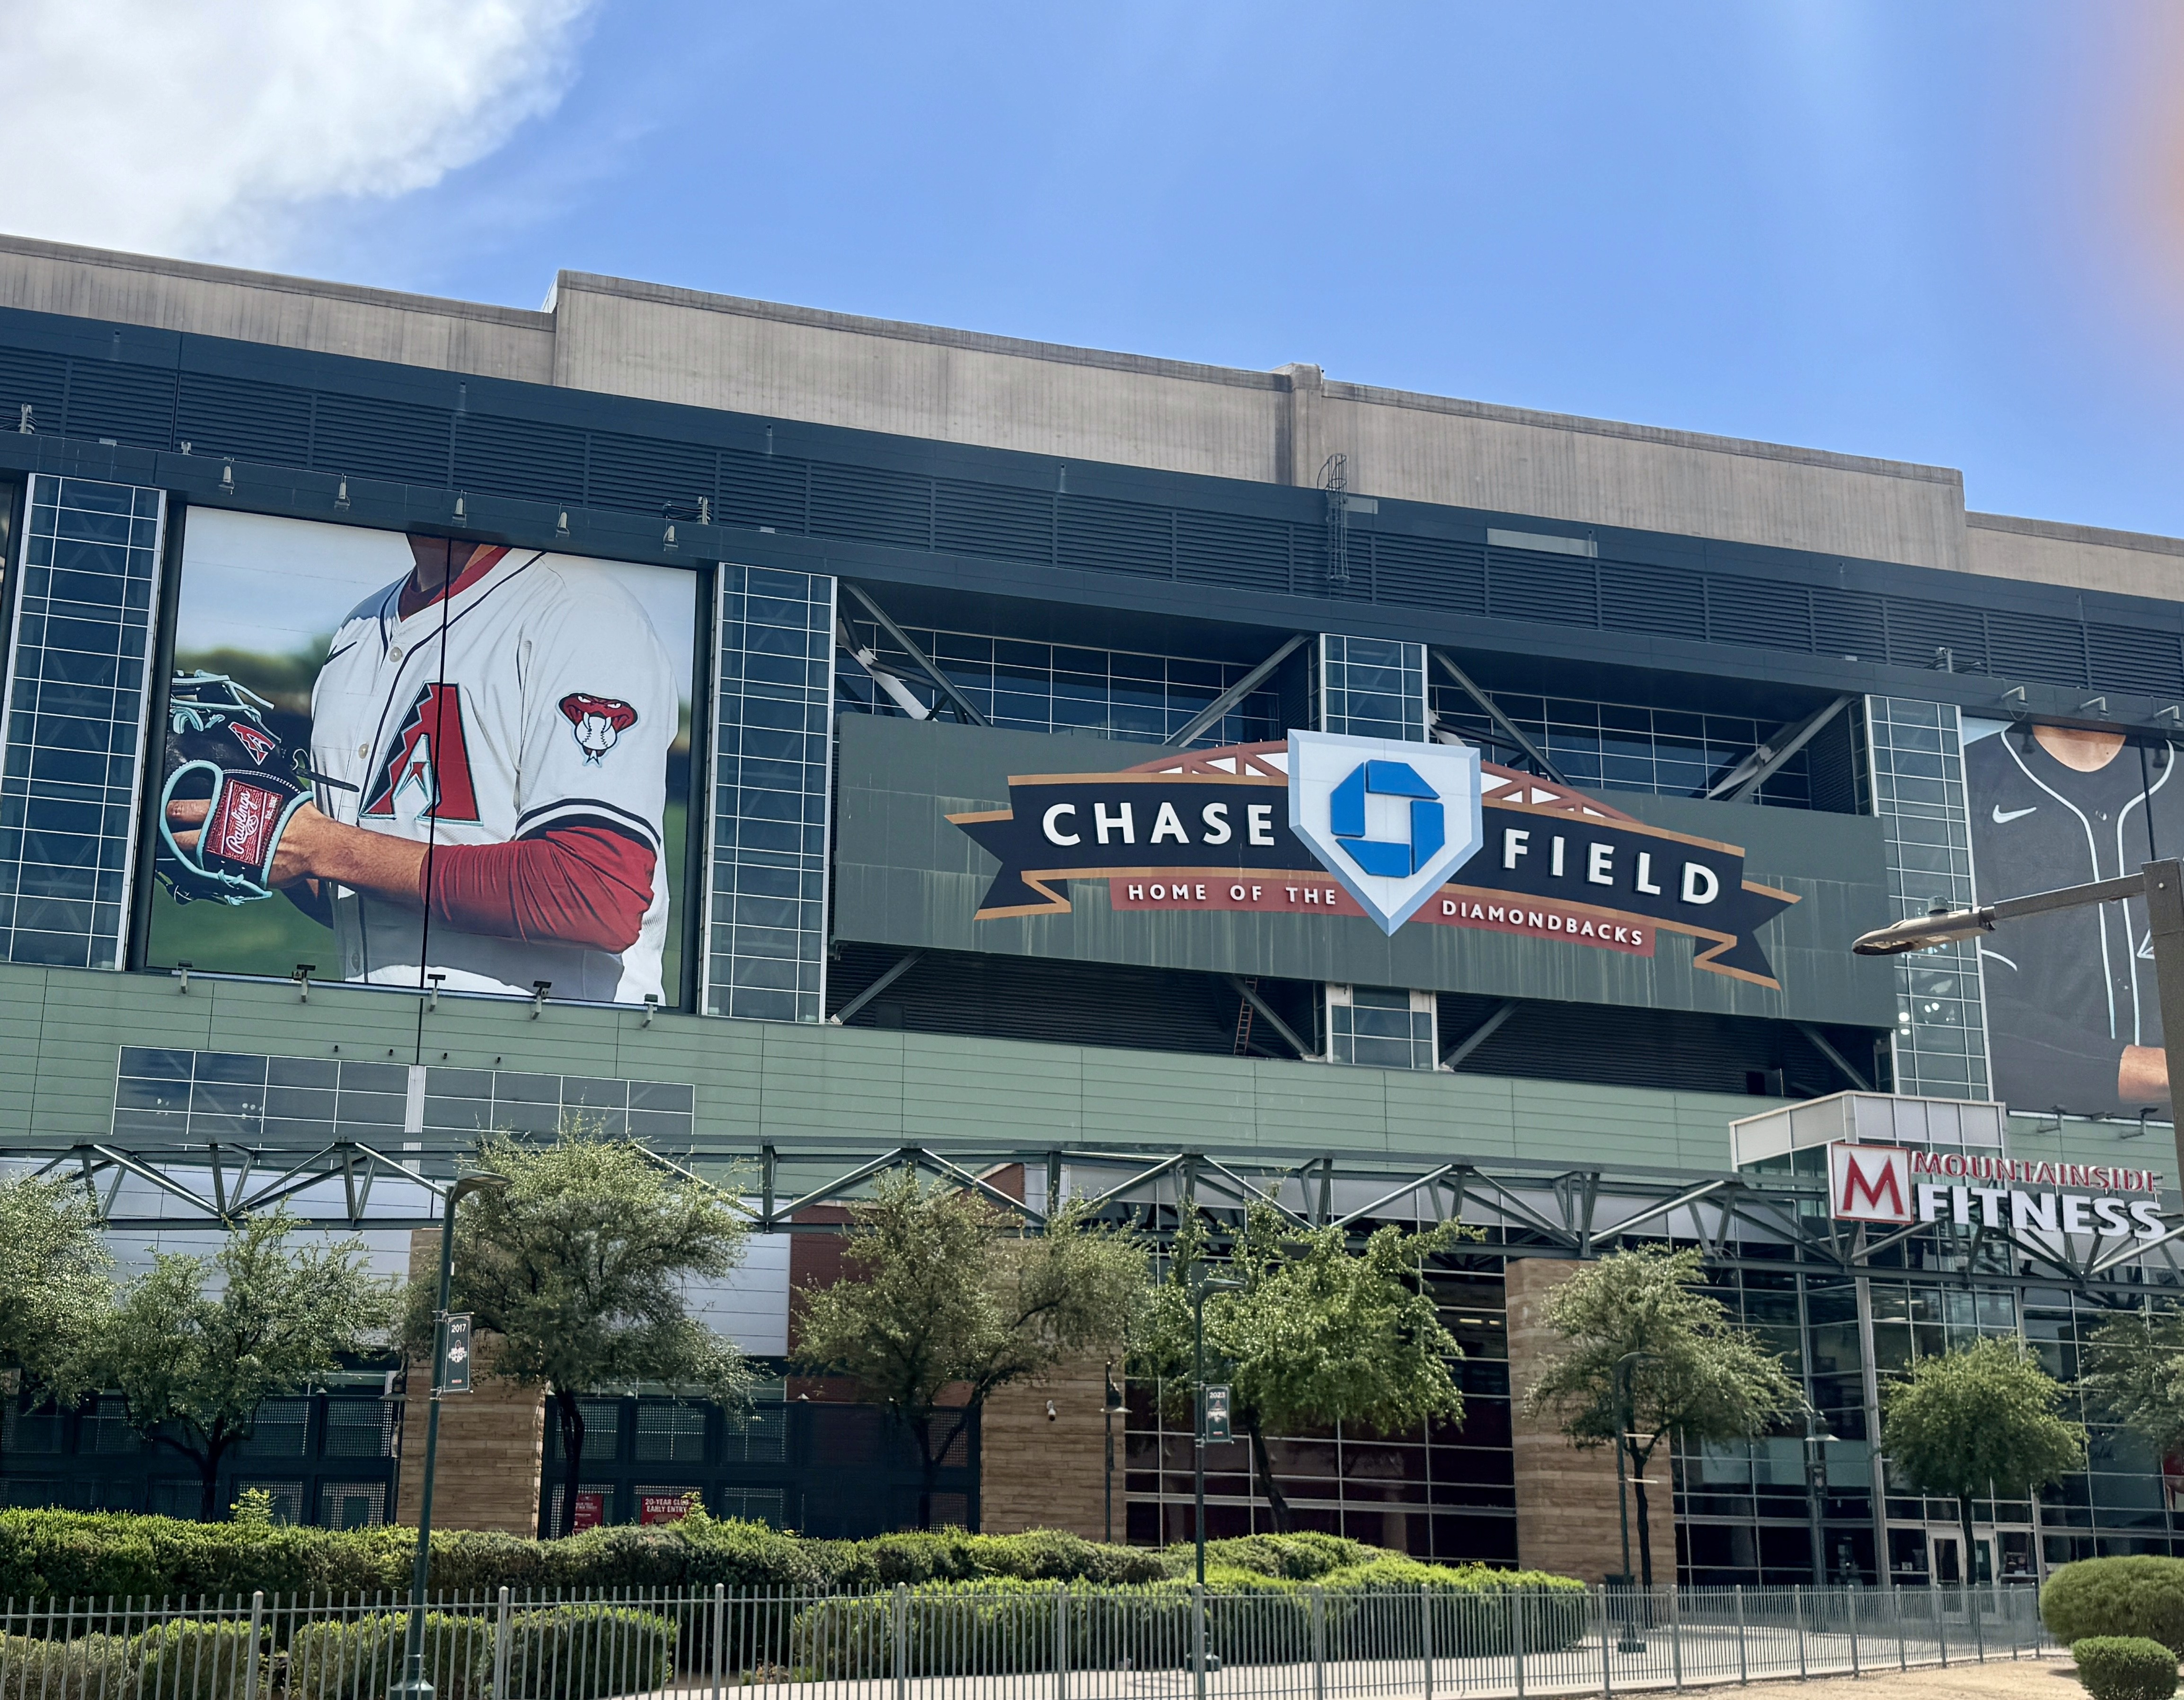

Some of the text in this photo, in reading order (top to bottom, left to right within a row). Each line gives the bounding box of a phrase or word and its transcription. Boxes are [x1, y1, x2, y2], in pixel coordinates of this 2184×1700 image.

[226, 791, 257, 854] Rawlings
[1042, 802, 1719, 904] CHASE FIELD
[1128, 884, 1642, 946] HOME OF THE DIAMONDBACKS
[1843, 1151, 1904, 1215] M
[1917, 1183, 2166, 1239] FITNESS
[451, 1323, 467, 1333] 2017
